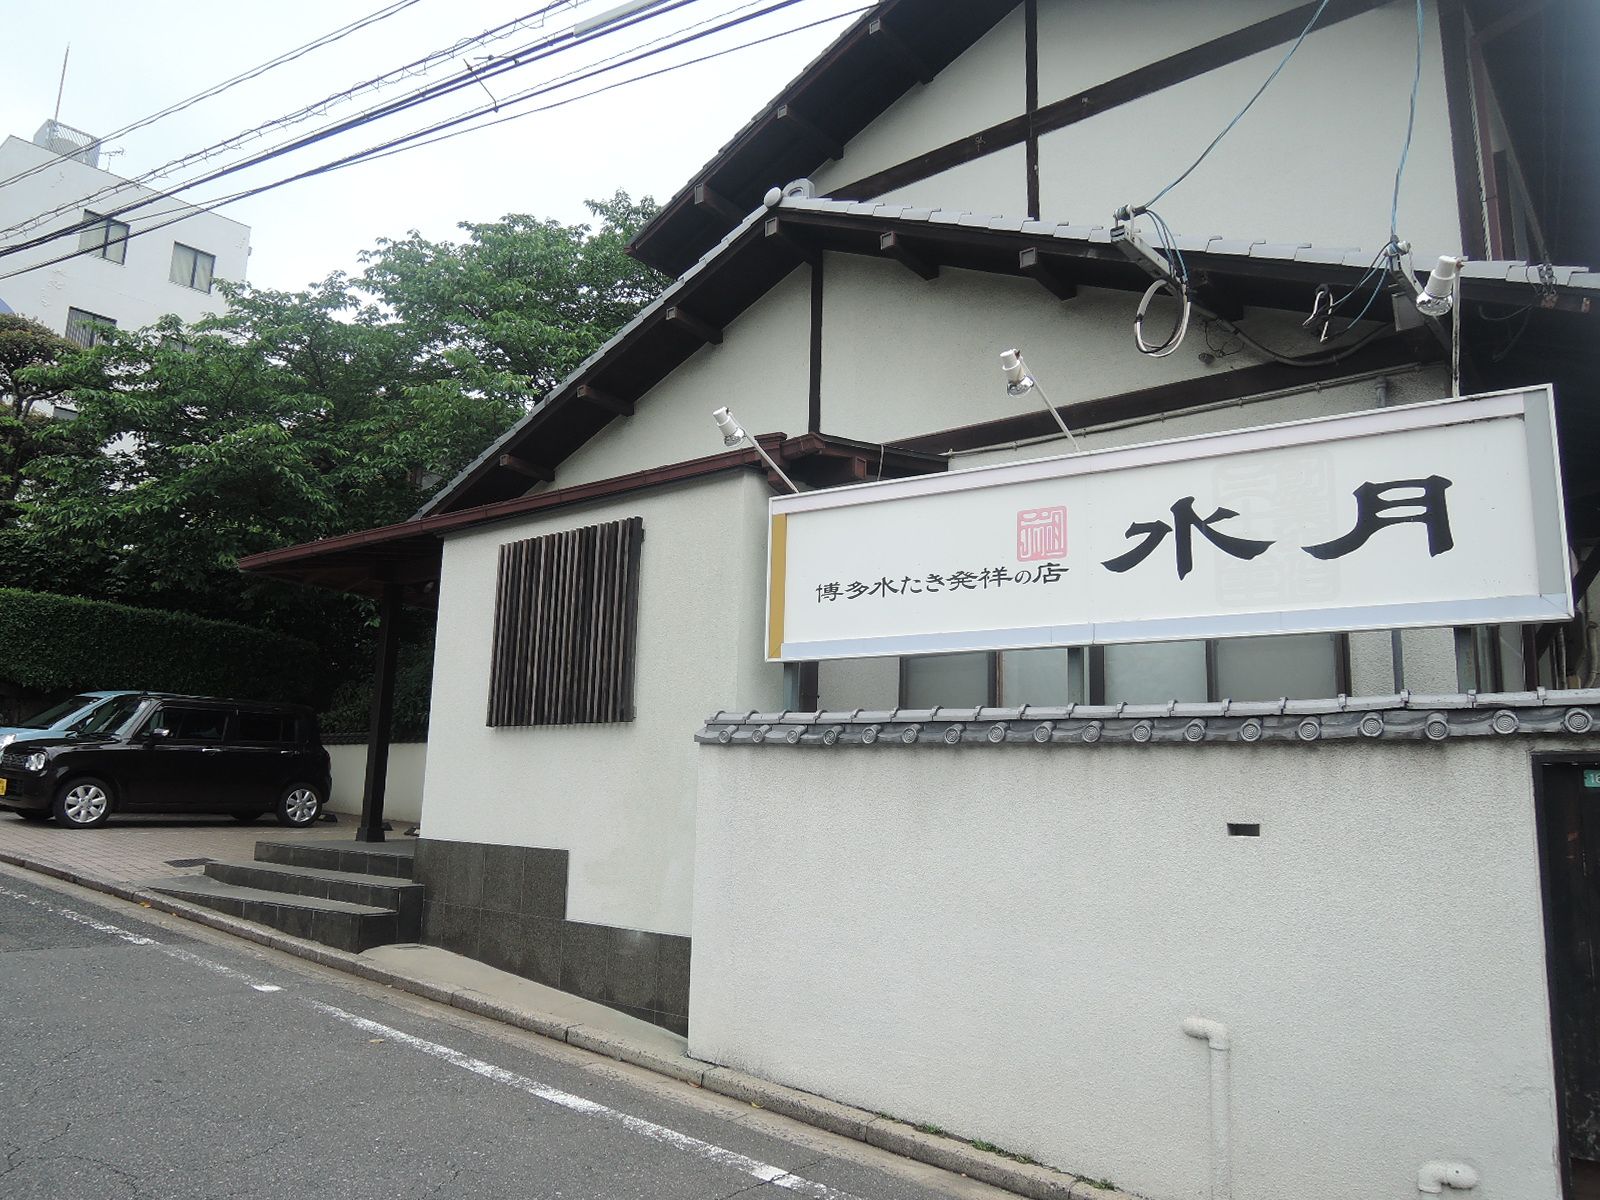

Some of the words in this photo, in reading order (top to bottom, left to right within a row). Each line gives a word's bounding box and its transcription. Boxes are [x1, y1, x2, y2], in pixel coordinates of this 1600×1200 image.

[1100, 474, 1454, 581] 水月
[816, 562, 1069, 603] 博多水たき発祥の店
